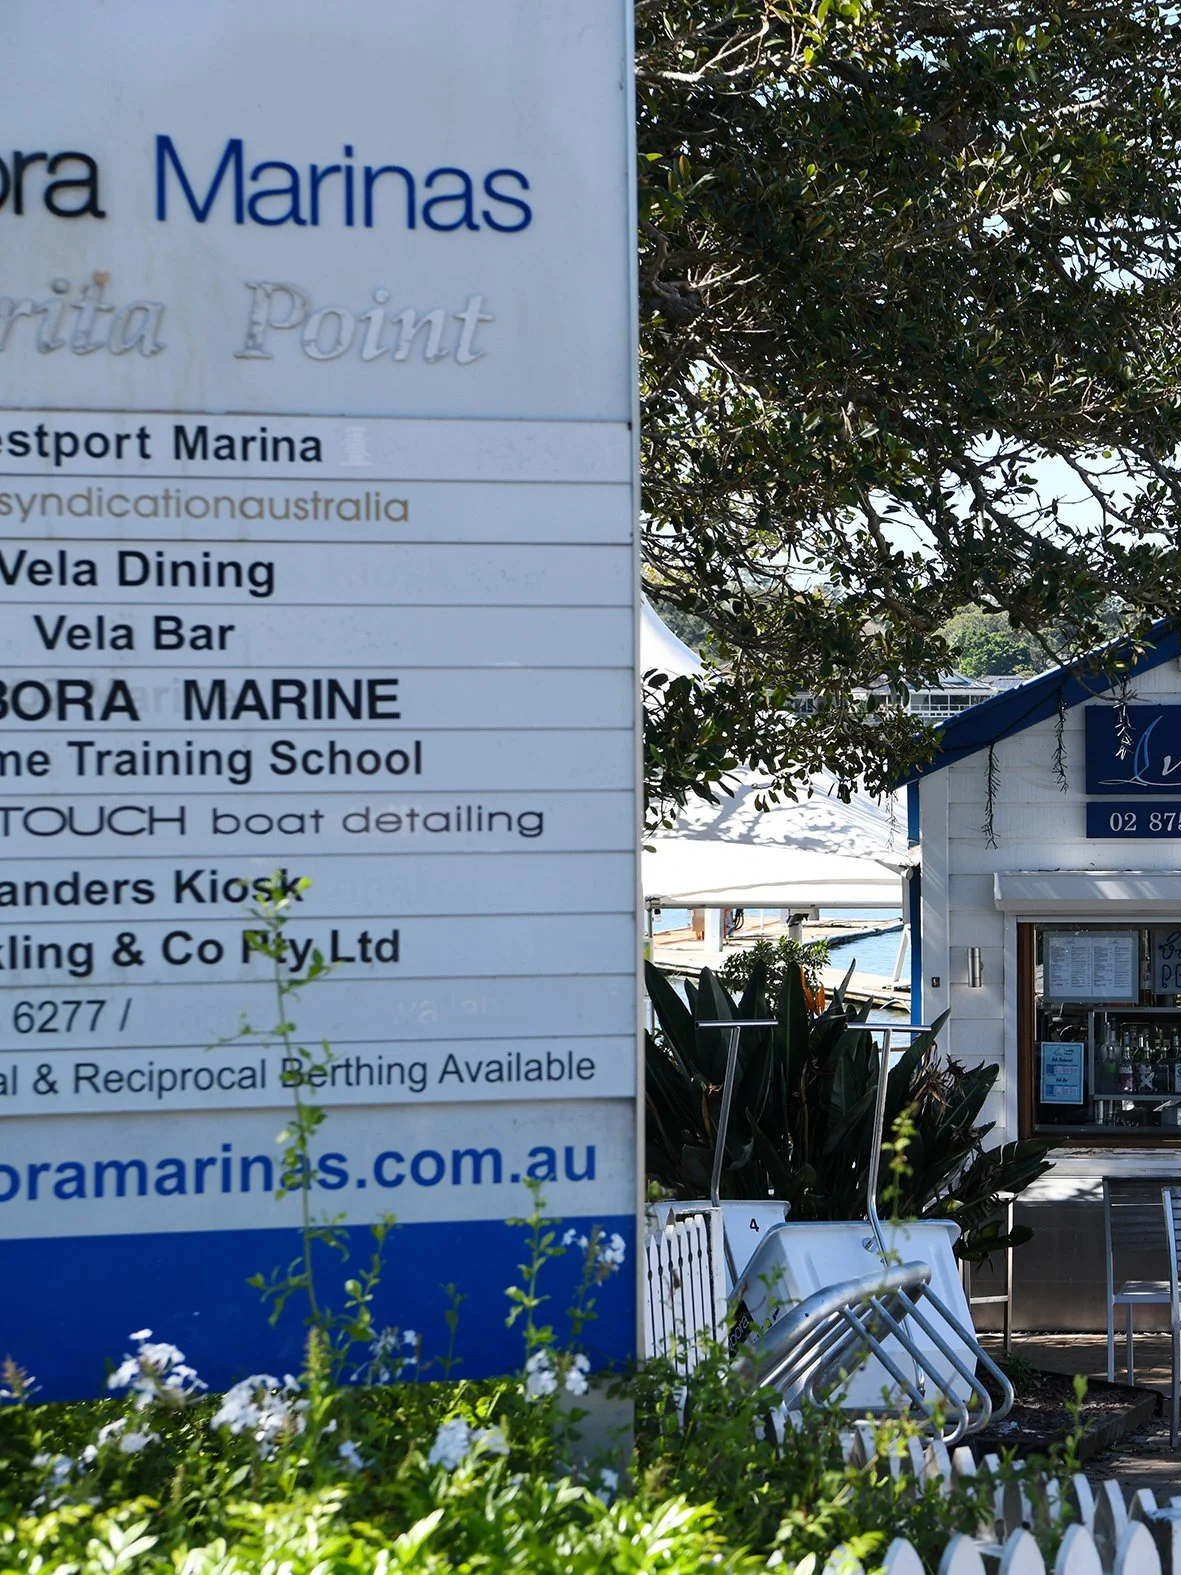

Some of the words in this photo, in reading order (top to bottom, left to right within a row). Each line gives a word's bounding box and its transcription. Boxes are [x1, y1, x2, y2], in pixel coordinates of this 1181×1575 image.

[0, 150, 107, 219] ra
[155, 134, 533, 235] Marinas
[235, 281, 495, 365] Point
[0, 423, 152, 468] stport
[174, 426, 323, 464] Marina
[0, 486, 410, 524] syndicationaustralia
[0, 549, 98, 587] Vela
[117, 550, 276, 597] Dining
[33, 614, 135, 651] Vela
[154, 615, 235, 651] Bar
[0, 679, 140, 721] ORA
[183, 678, 402, 721] MARINE
[66, 740, 252, 784] Training
[270, 740, 423, 777] School
[0, 805, 186, 838] TOUCH
[212, 807, 324, 836] boat
[342, 803, 545, 838] detailing
[1109, 812, 1137, 832] 02
[0, 870, 156, 908] anders
[174, 868, 304, 904] Kiosk
[0, 934, 95, 978] ling
[112, 931, 145, 968] &
[161, 930, 224, 966] Co
[331, 928, 400, 964] Ltd
[13, 999, 107, 1034] 6277
[118, 997, 133, 1033] /
[33, 1063, 60, 1096] &
[73, 1059, 267, 1101] Reciprocal
[281, 1054, 427, 1093] Berthing
[438, 1051, 596, 1084] Available
